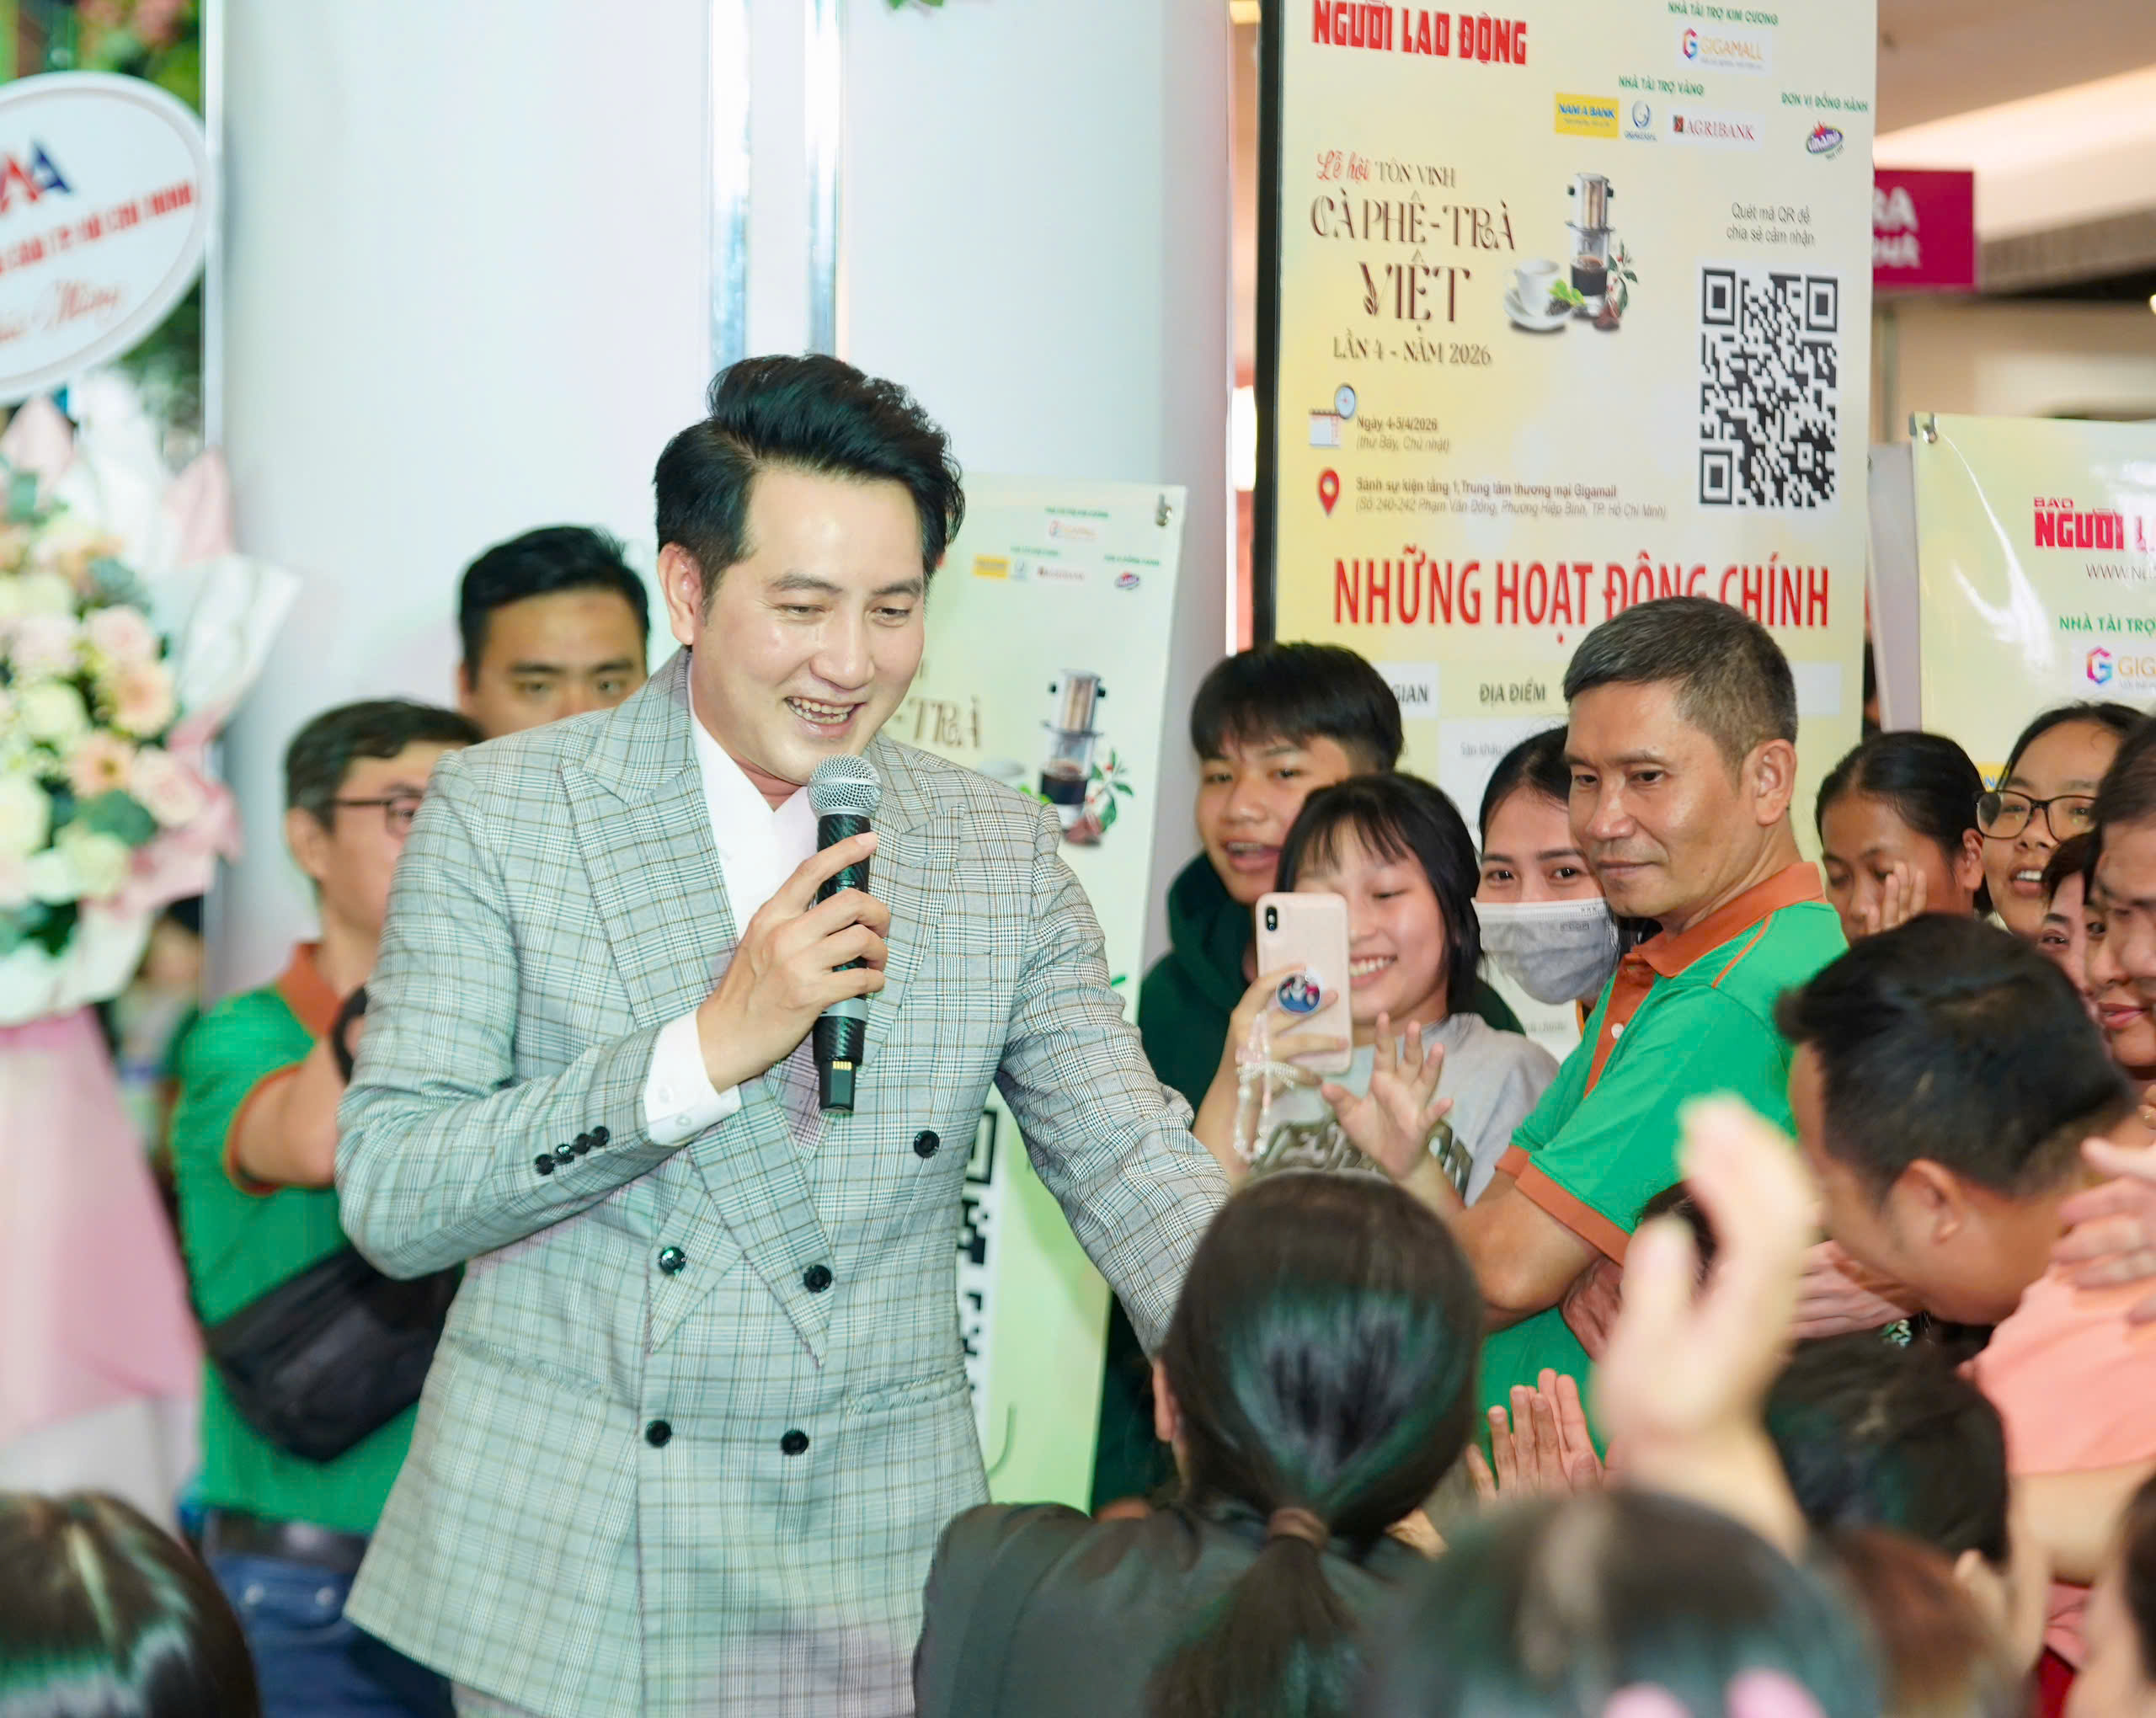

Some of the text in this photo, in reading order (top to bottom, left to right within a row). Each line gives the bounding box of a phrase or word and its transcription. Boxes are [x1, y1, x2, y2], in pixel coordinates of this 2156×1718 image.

[1401, 8, 1450, 56] LAO
[1457, 12, 1527, 64] ĐỘNG
[1590, 105, 1615, 120] BANK
[1685, 118, 1756, 141] AGRIBANK
[1374, 157, 1412, 184] TÔN
[1416, 163, 1456, 189] VINH
[1310, 187, 1356, 239] CÀ
[1732, 201, 1757, 220] Quét
[1778, 205, 1795, 223] QR
[1726, 223, 1748, 242] chia
[1790, 228, 1814, 247] nhận
[1358, 249, 1471, 333] VIỆT
[1333, 328, 1368, 360] LẦN
[1373, 338, 1383, 360] 4
[1449, 342, 1492, 365] 2026
[1357, 414, 1383, 432] Ngày
[1402, 478, 1424, 494] kiện
[1492, 480, 1512, 494] tâm
[1514, 481, 1551, 499] thương
[1554, 483, 1572, 499] mại
[1574, 483, 1617, 499] Gigamall
[1333, 543, 1481, 626] NHỮNG
[1495, 559, 1593, 644] HOẠT
[1719, 551, 1829, 627] CHÍNH
[2059, 611, 2093, 632] NHÀ
[2098, 612, 2122, 632] TÀI
[1479, 676, 1546, 710] ĐỊA ĐIỂM
